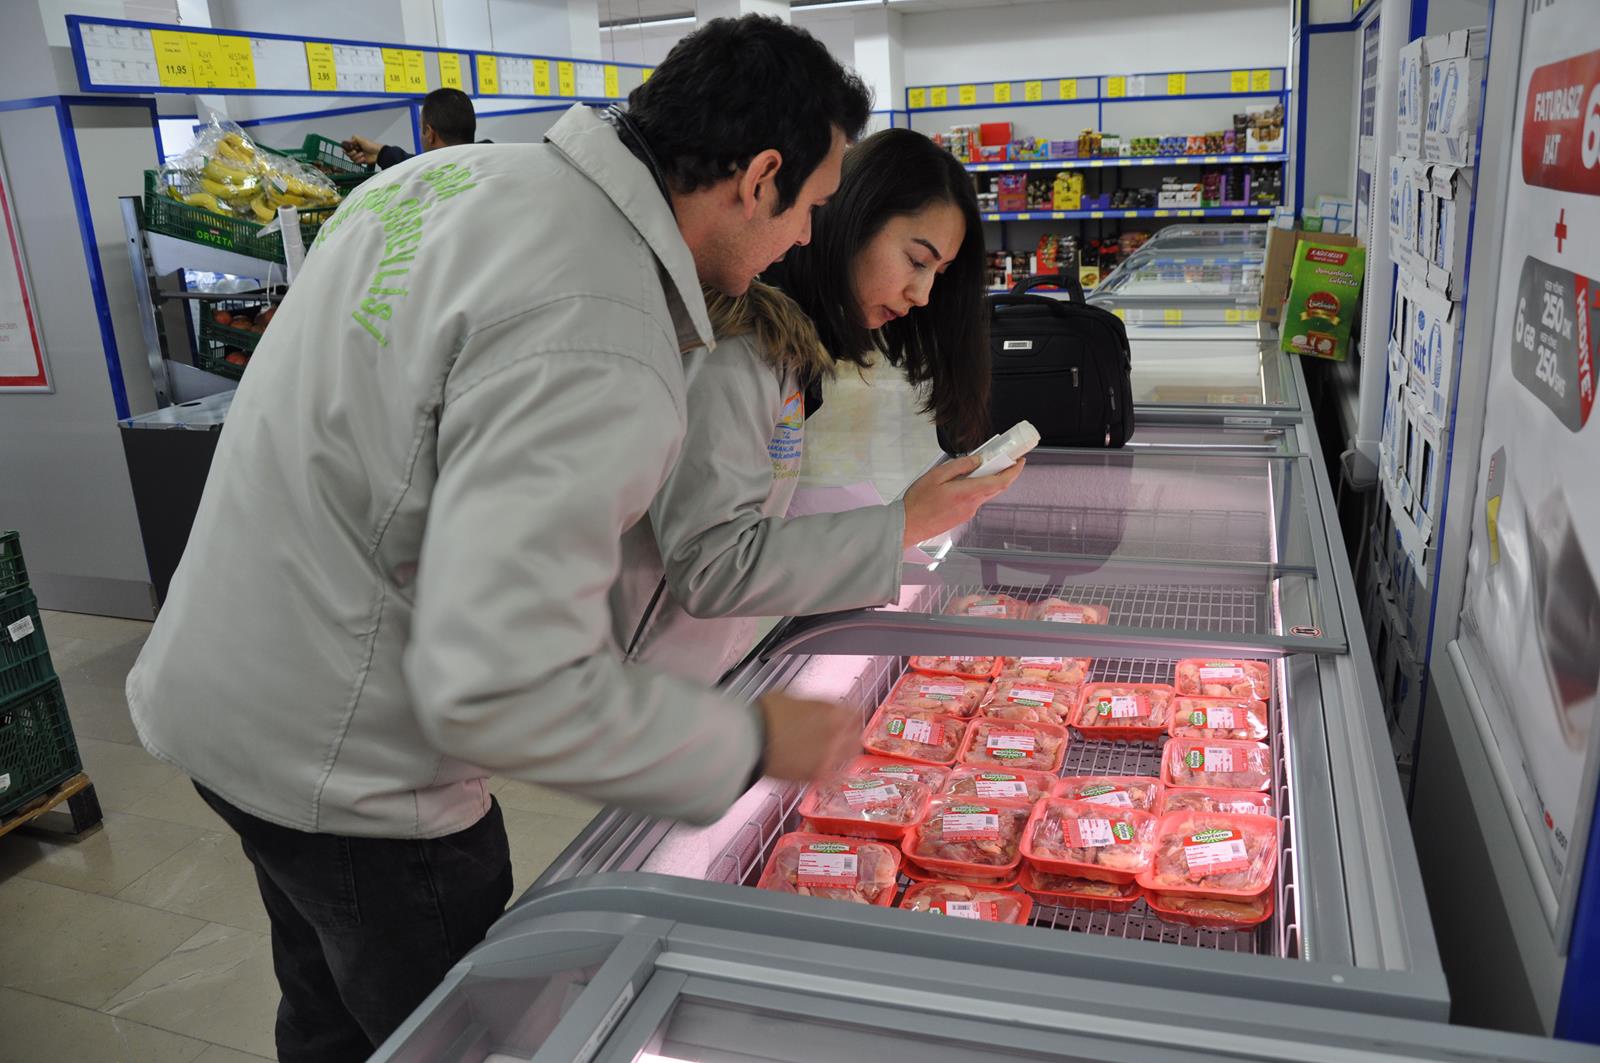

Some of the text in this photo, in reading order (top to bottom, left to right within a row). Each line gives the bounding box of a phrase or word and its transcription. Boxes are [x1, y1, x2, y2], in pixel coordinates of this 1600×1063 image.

[166, 65, 187, 75] 11,95
[1534, 84, 1584, 122] FATURASIZ
[1543, 134, 1561, 165] HAT
[1515, 297, 1536, 352] 6 GB
[1541, 291, 1564, 333] 250
[1535, 345, 1557, 388] 250
[813, 843, 846, 851] Doyfarm
[1195, 831, 1229, 841] Doyfarm
